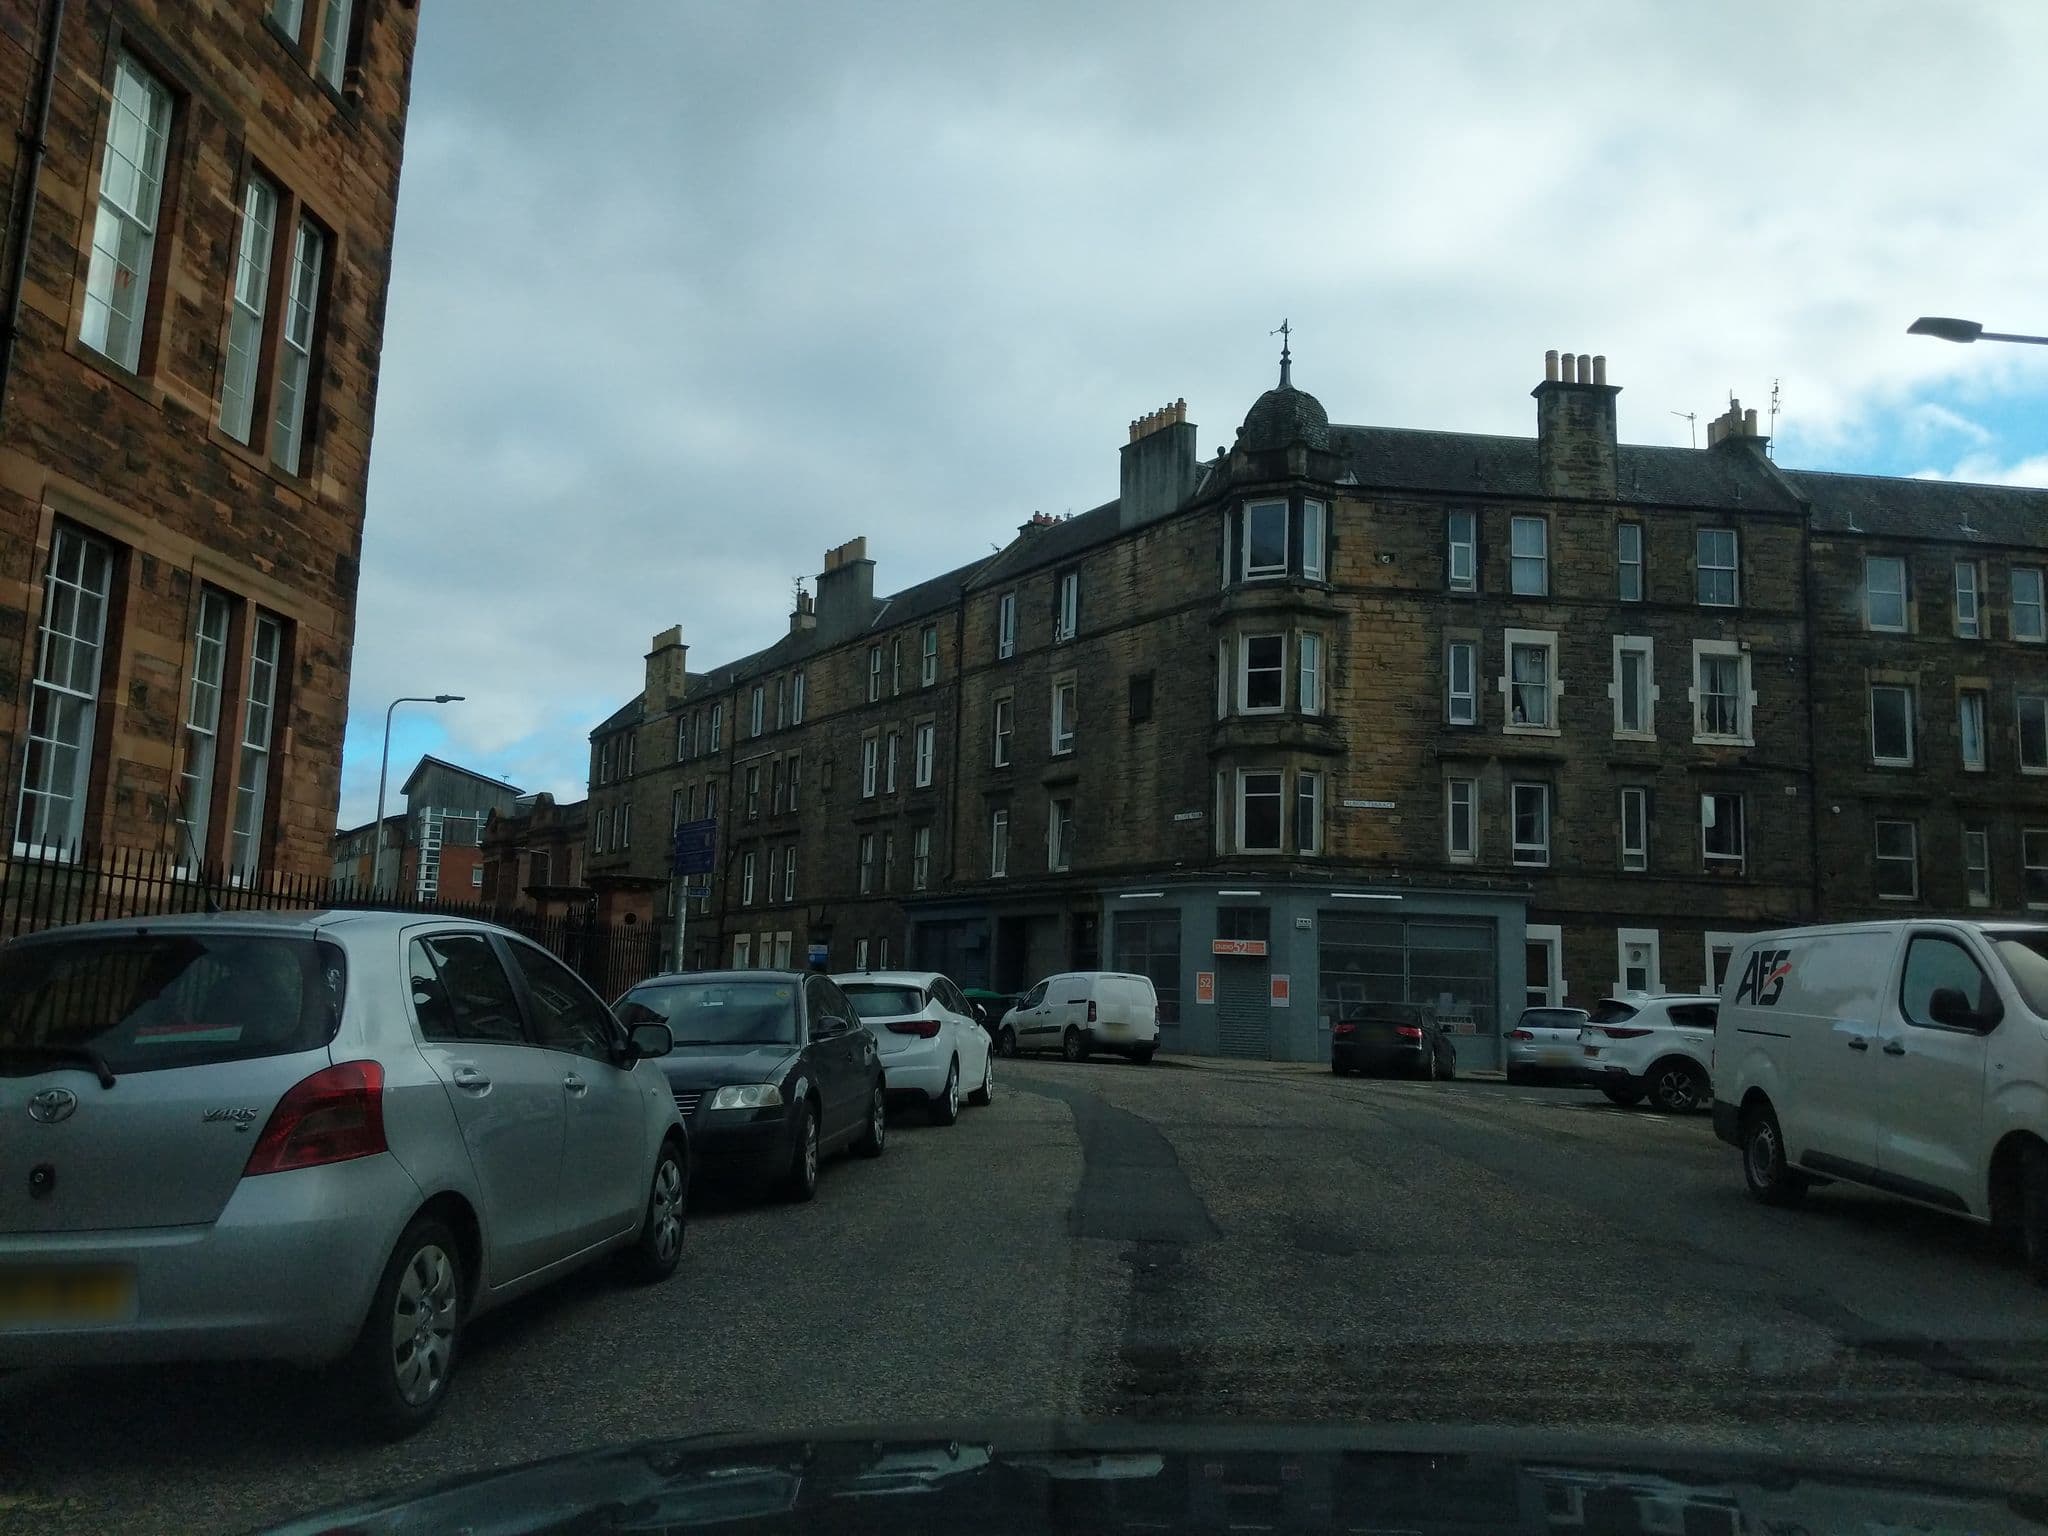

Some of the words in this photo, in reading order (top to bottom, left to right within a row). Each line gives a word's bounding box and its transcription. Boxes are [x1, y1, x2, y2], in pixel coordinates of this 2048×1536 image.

[1234, 940, 1248, 953] 52
[1199, 977, 1211, 988] 52
[1735, 950, 1791, 1005] AES
